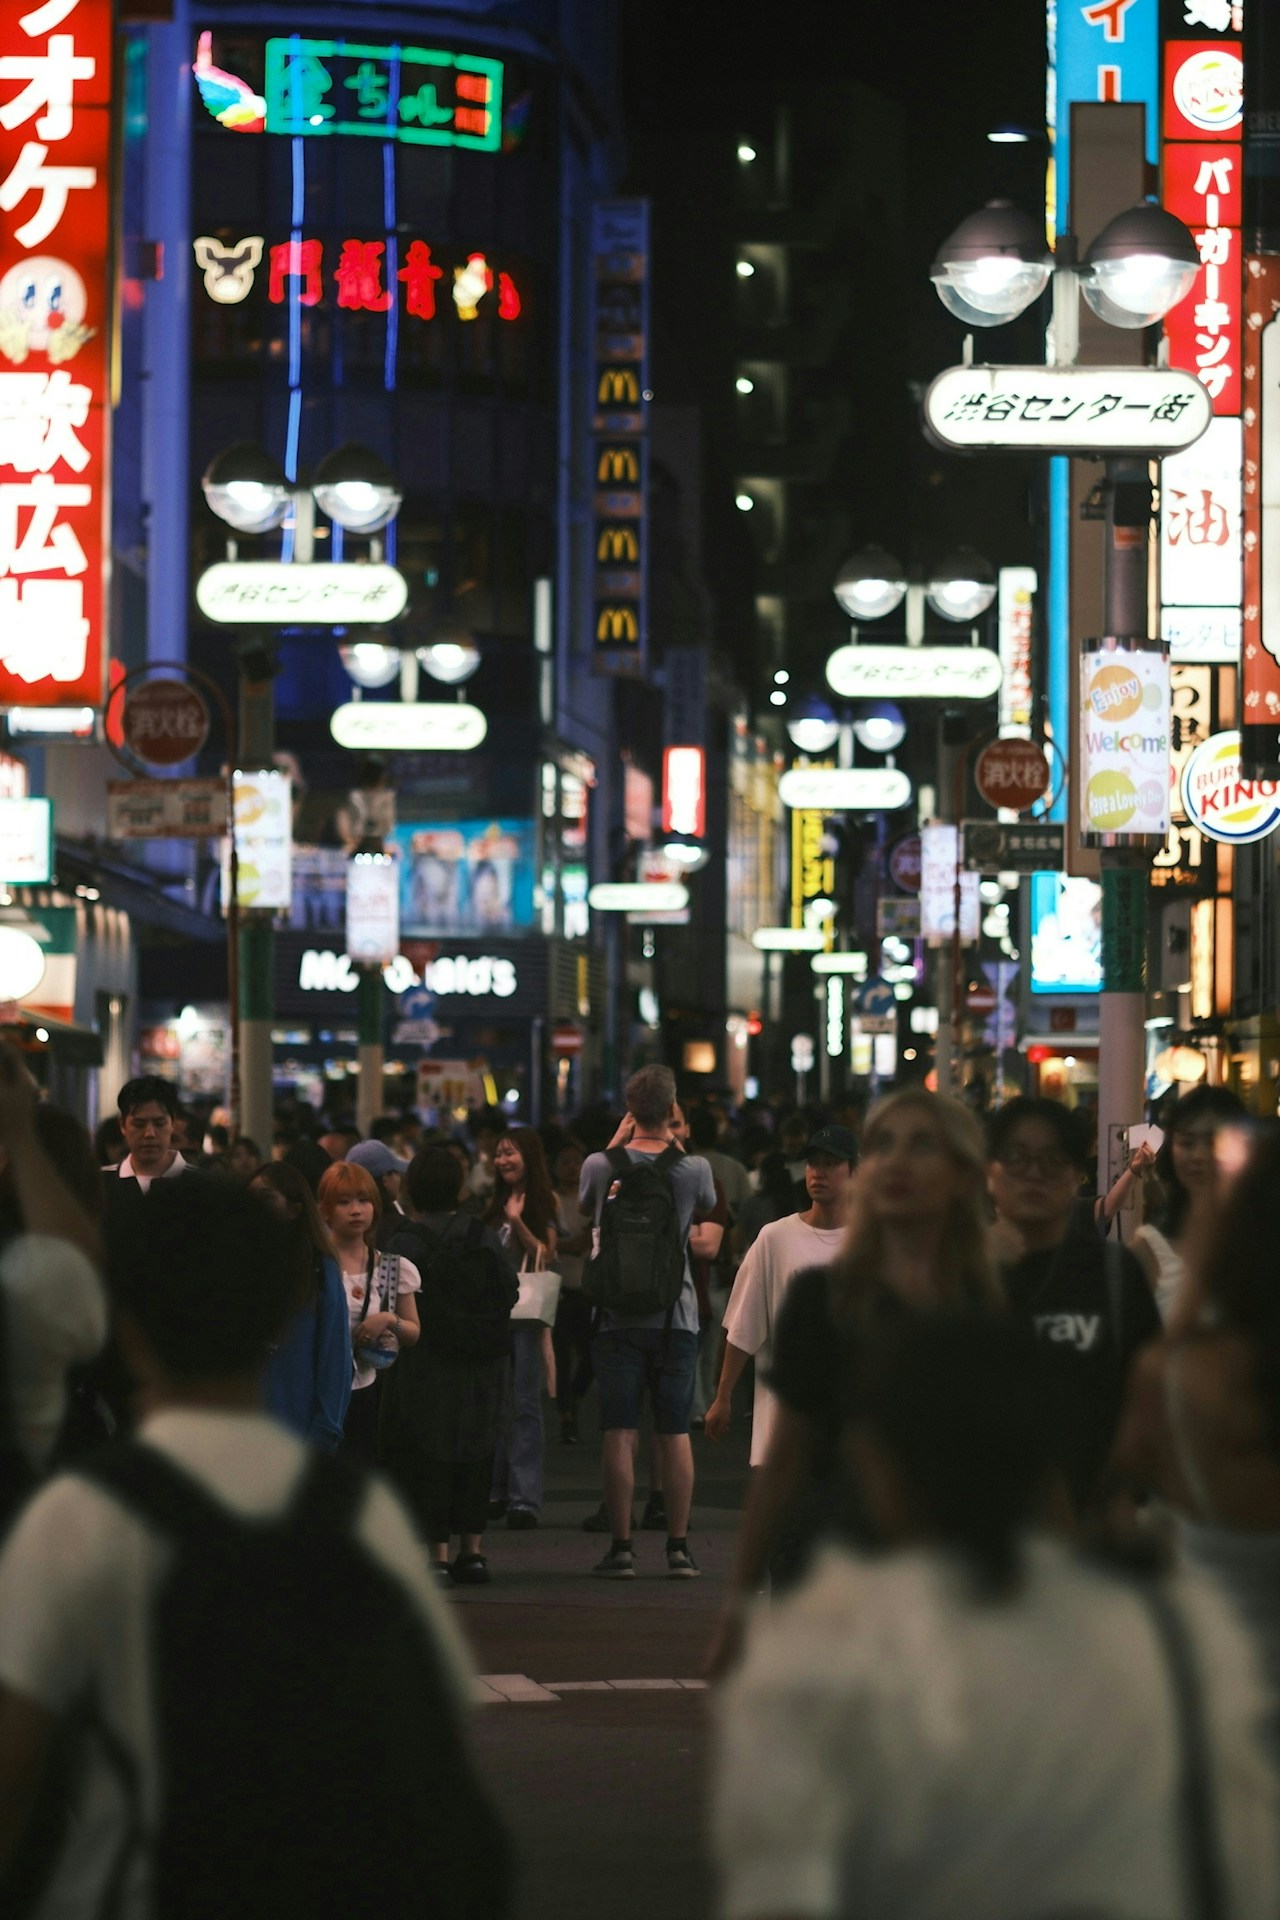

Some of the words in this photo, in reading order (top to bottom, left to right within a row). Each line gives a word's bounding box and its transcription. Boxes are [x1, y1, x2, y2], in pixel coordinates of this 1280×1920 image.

[1193, 158, 1231, 398] バーガーキング
[944, 393, 1196, 422] 渋谷センター街
[1168, 489, 1227, 546] 油
[1091, 677, 1138, 714] Enjoy
[1086, 732, 1167, 754] Welcome
[983, 760, 1044, 789] 消火栓
